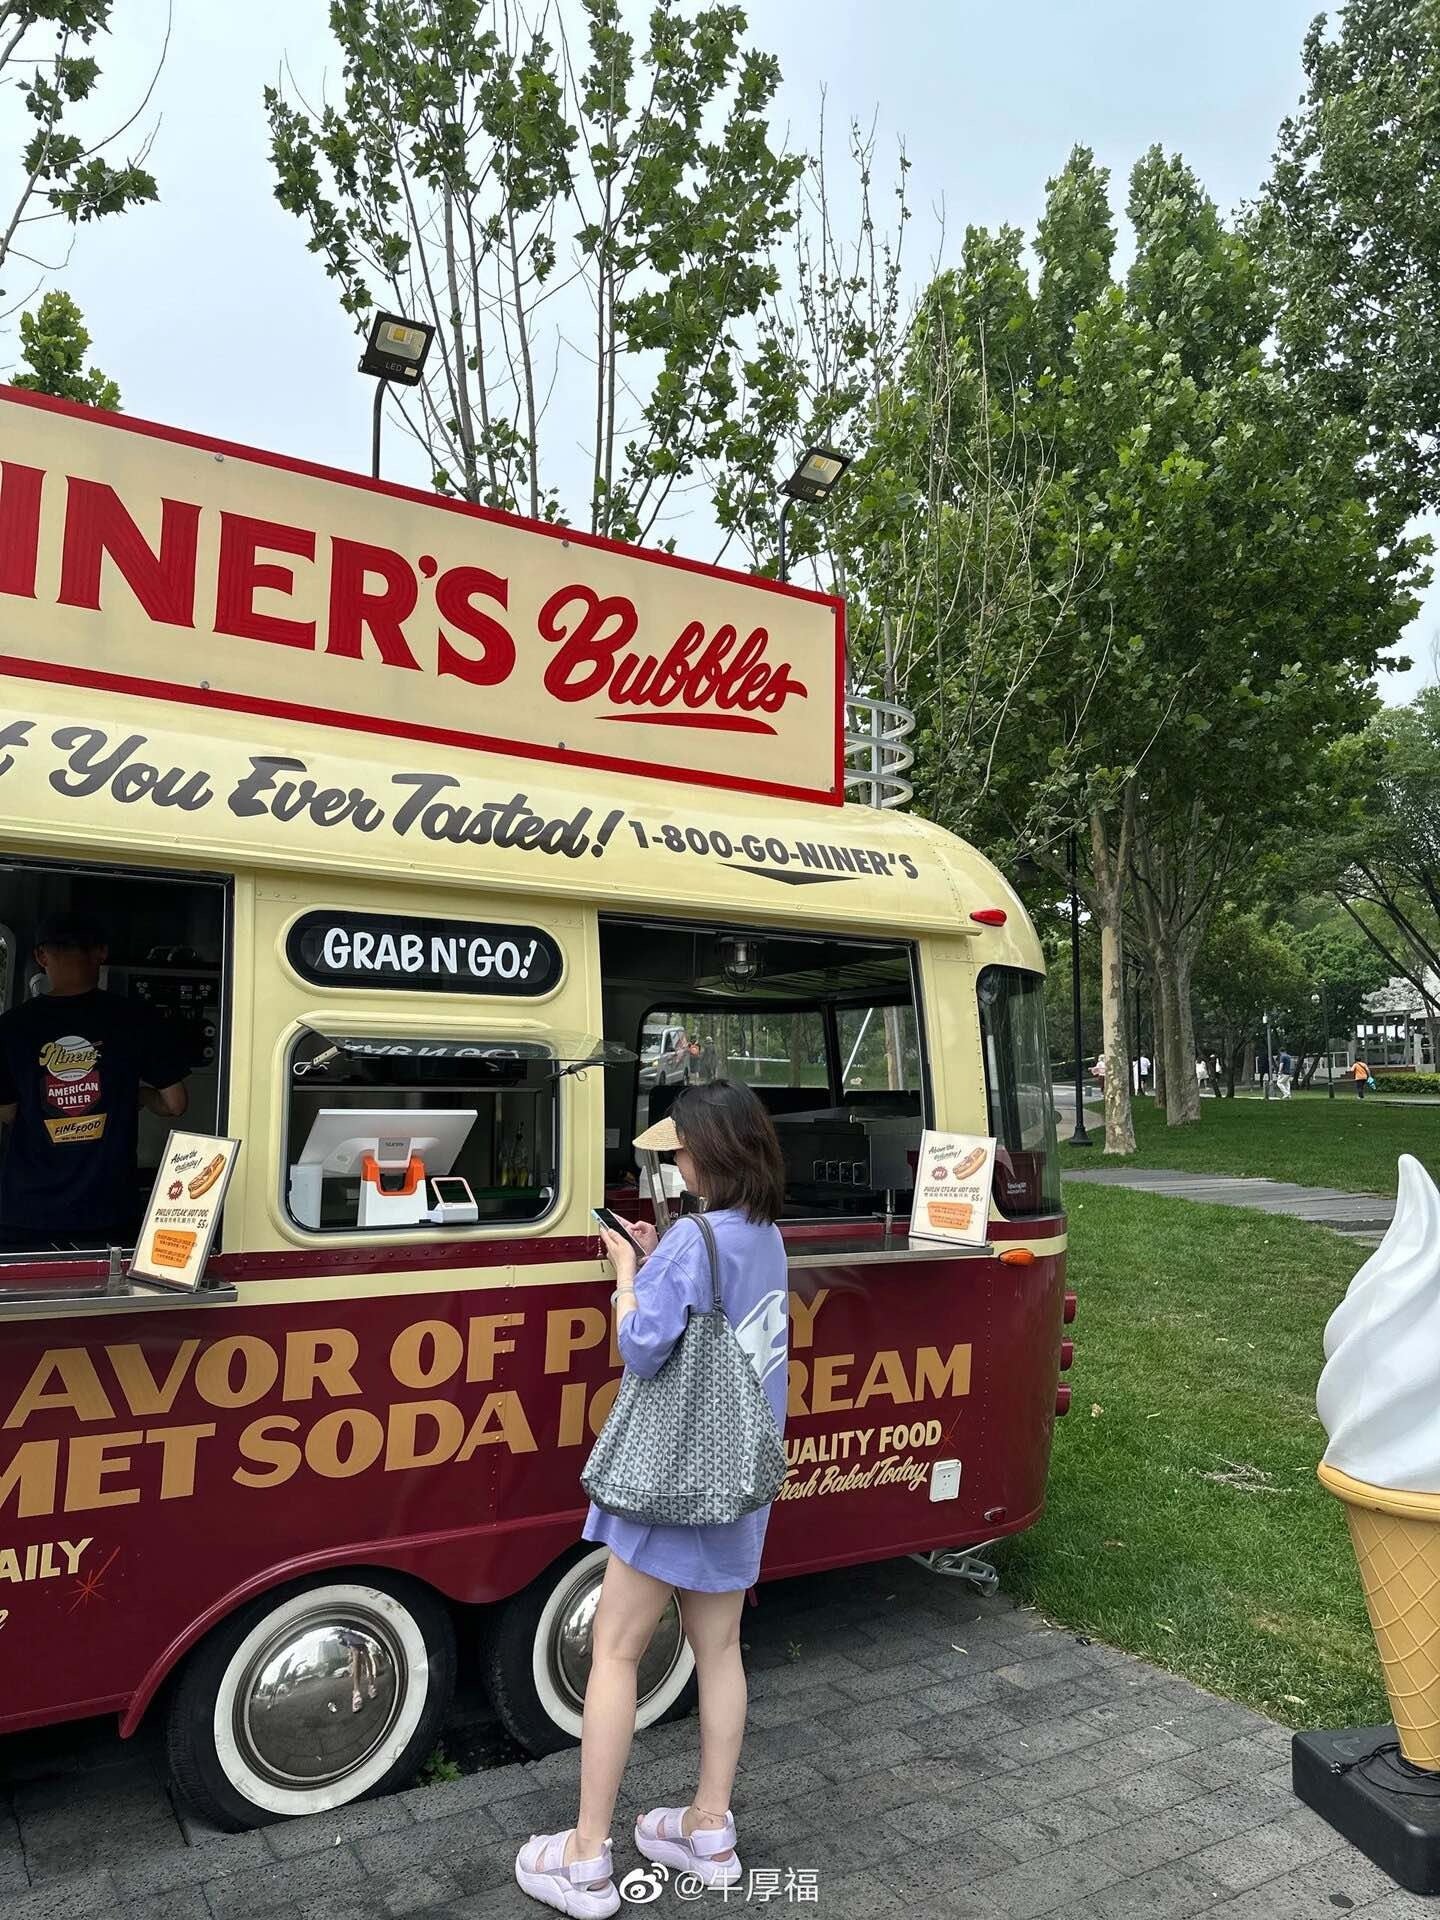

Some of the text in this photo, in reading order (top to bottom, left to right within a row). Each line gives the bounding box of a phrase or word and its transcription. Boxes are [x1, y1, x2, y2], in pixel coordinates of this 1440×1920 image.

[385, 362, 402, 372] LED
[537, 584, 808, 713] Bubbles
[48, 726, 213, 812] You
[229, 756, 385, 830] Ever
[390, 772, 625, 859] Tasted!
[628, 819, 919, 880] 1-800-GO-NINER'S
[322, 927, 424, 973] GRAB
[48, 1083, 98, 1096] AMERICAN
[57, 1095, 91, 1105] DINER
[55, 1121, 101, 1134] FINE FOOD
[390, 1313, 525, 1389] OF
[232, 1391, 538, 1488] SODA
[783, 1419, 943, 1467] UALITY FOOD
[817, 1461, 881, 1496] Baked
[874, 1455, 931, 1492] Today
